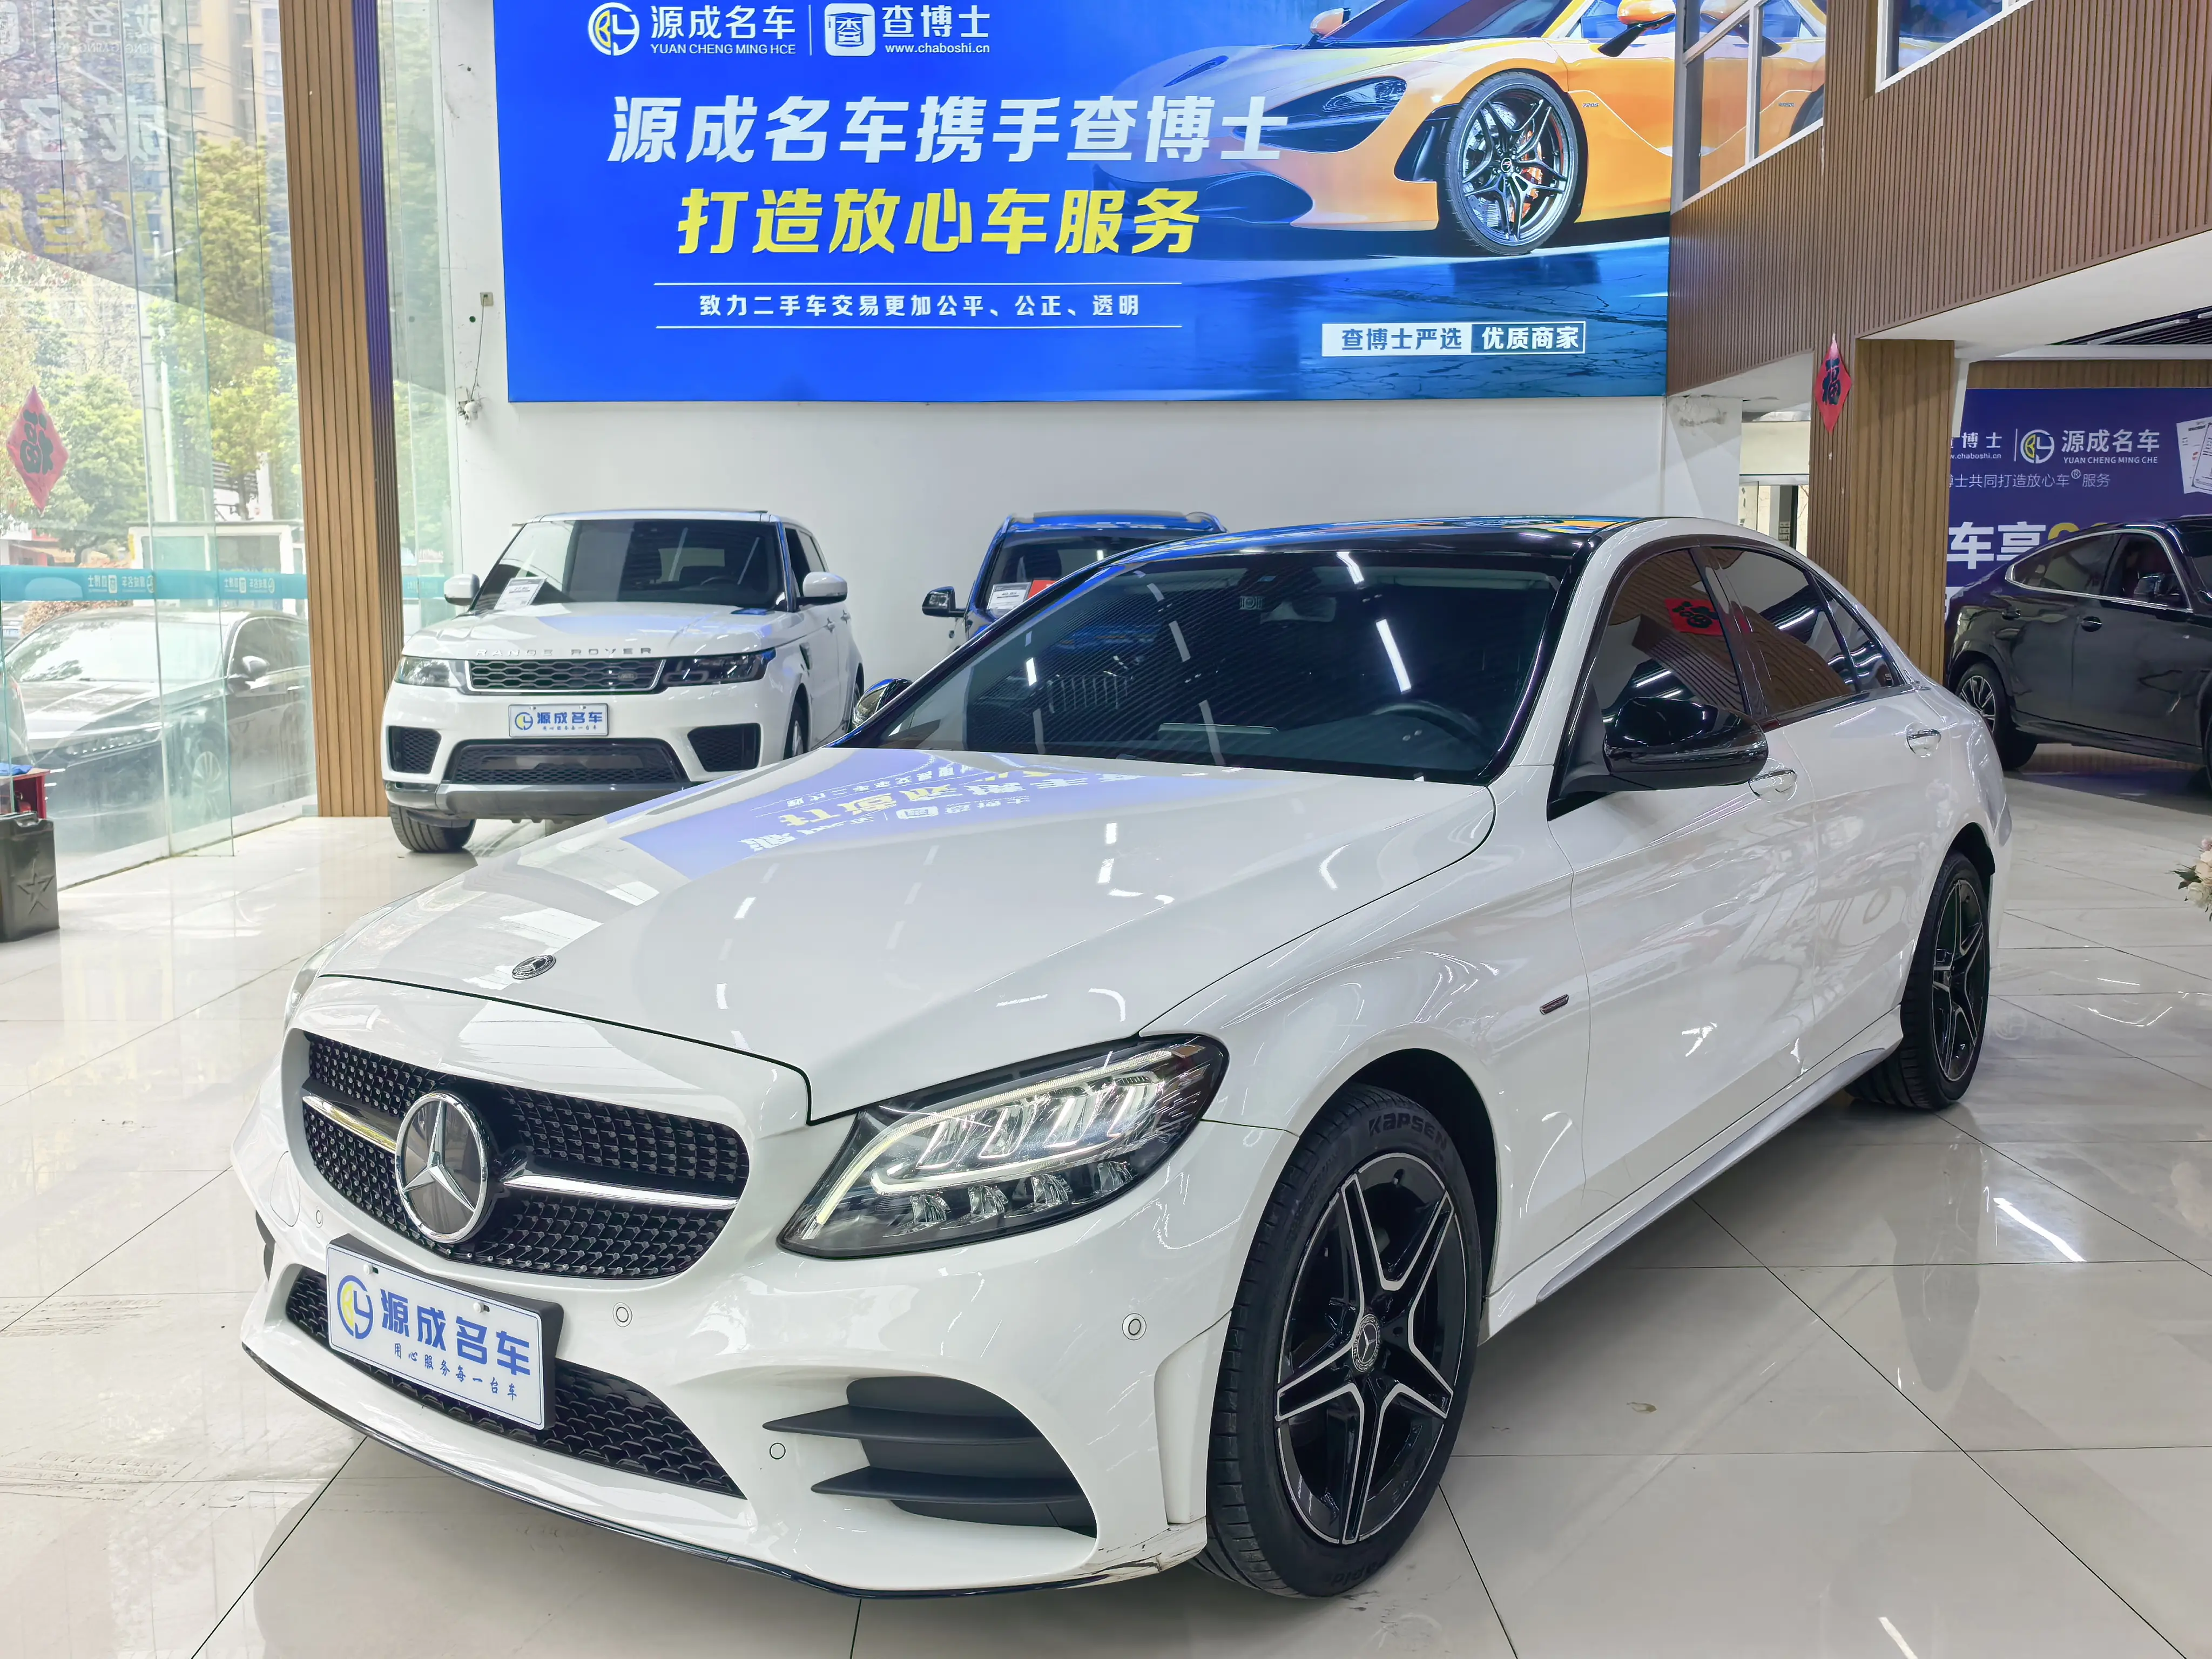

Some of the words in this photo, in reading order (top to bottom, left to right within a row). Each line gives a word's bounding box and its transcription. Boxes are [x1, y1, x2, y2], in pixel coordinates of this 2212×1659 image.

[651, 5, 795, 39] 源成名车
[882, 5, 990, 38] 查博士
[650, 44, 686, 54] YUAN
[689, 44, 735, 54] CHENG
[736, 44, 767, 54] MING
[770, 44, 796, 54] HCE
[885, 43, 990, 53] www.chaboshi.cn
[607, 95, 1288, 164] 源成名车携手查博士
[677, 188, 1200, 255] 打造放心车服务
[699, 294, 1139, 318] 致力二手车交易更加公平、公正、透明
[1341, 328, 1462, 350] 查博士严选
[1481, 326, 1580, 350] 优质商家
[1951, 432, 2002, 449] 博士
[2061, 429, 2160, 453] 源成名车
[2087, 456, 2116, 464] CHENG
[475, 649, 553, 657] RANGE
[571, 648, 651, 656] ROVER
[537, 712, 603, 724] 源成名车
[380, 1289, 531, 1377] 源成名车
[394, 1343, 517, 1401] 用心服务每一台车
